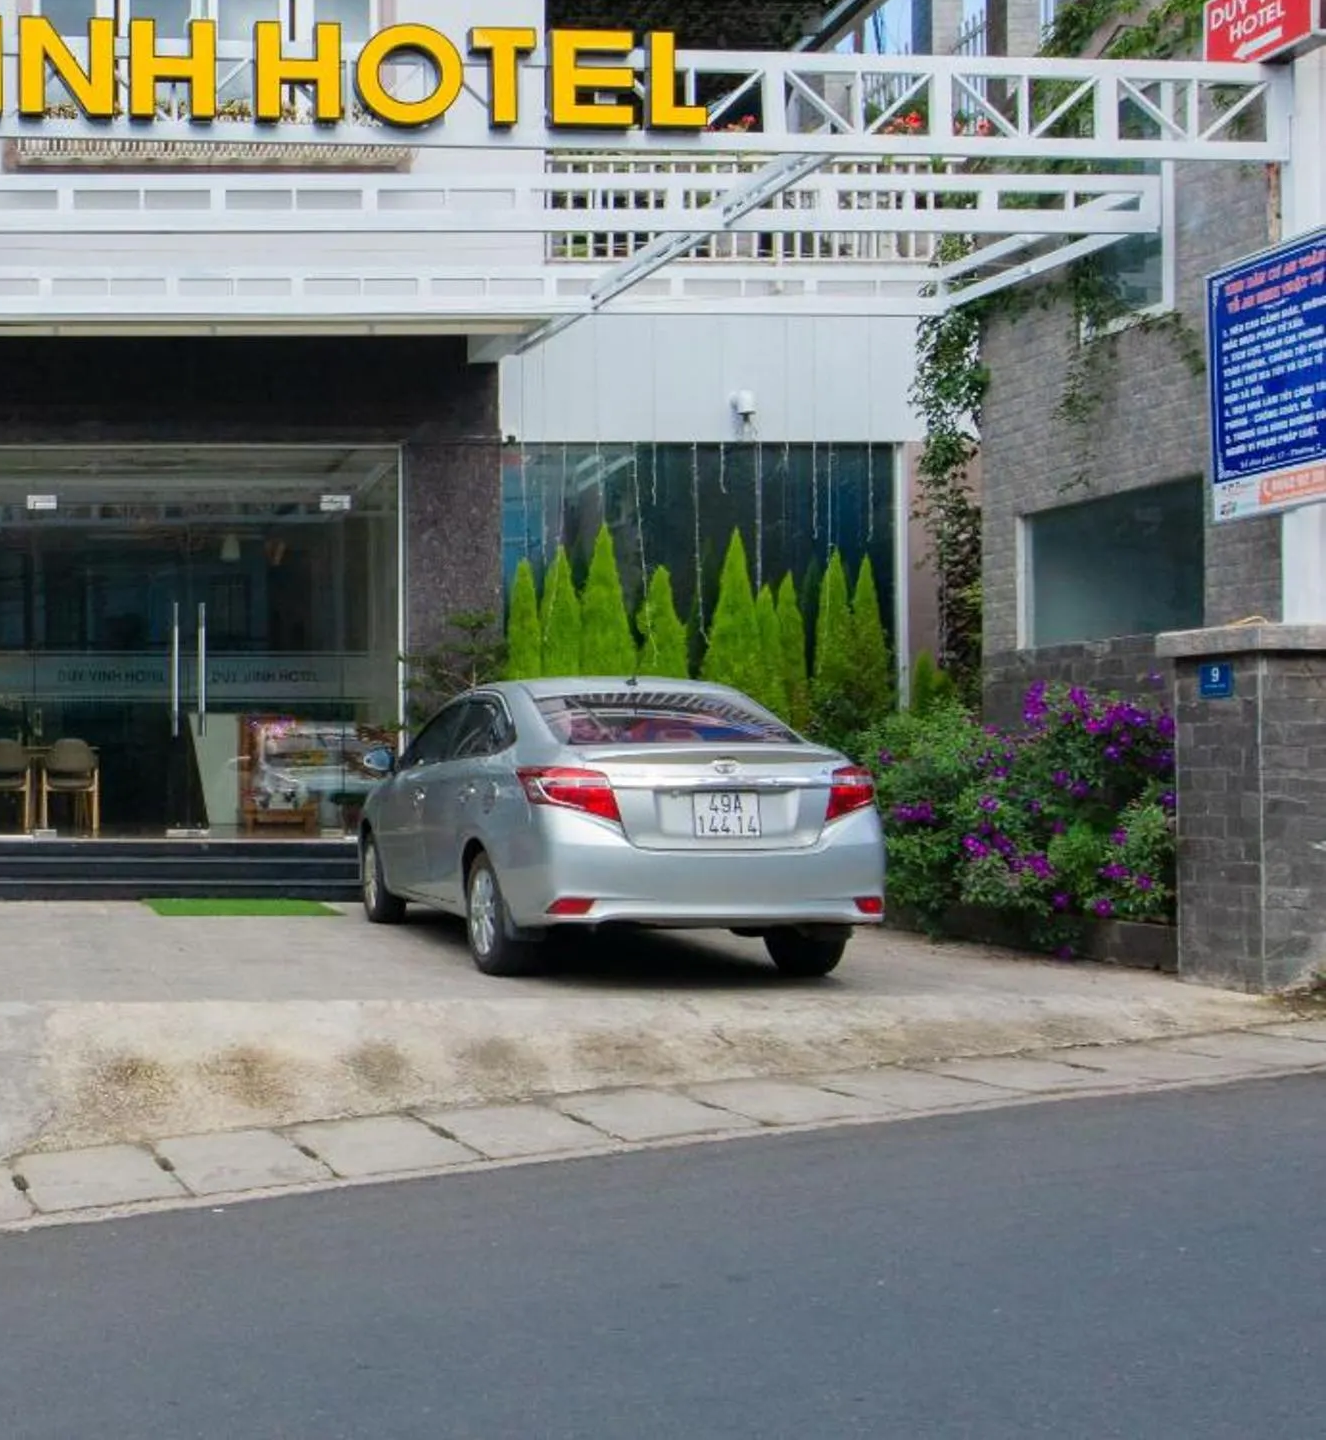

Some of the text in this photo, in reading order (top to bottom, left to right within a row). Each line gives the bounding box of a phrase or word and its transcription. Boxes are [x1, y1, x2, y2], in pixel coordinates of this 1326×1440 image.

[1229, 0, 1286, 43] HOTEL
[252, 22, 710, 131] HOTEL
[709, 792, 743, 813] 49A
[698, 815, 758, 835] 144.14
